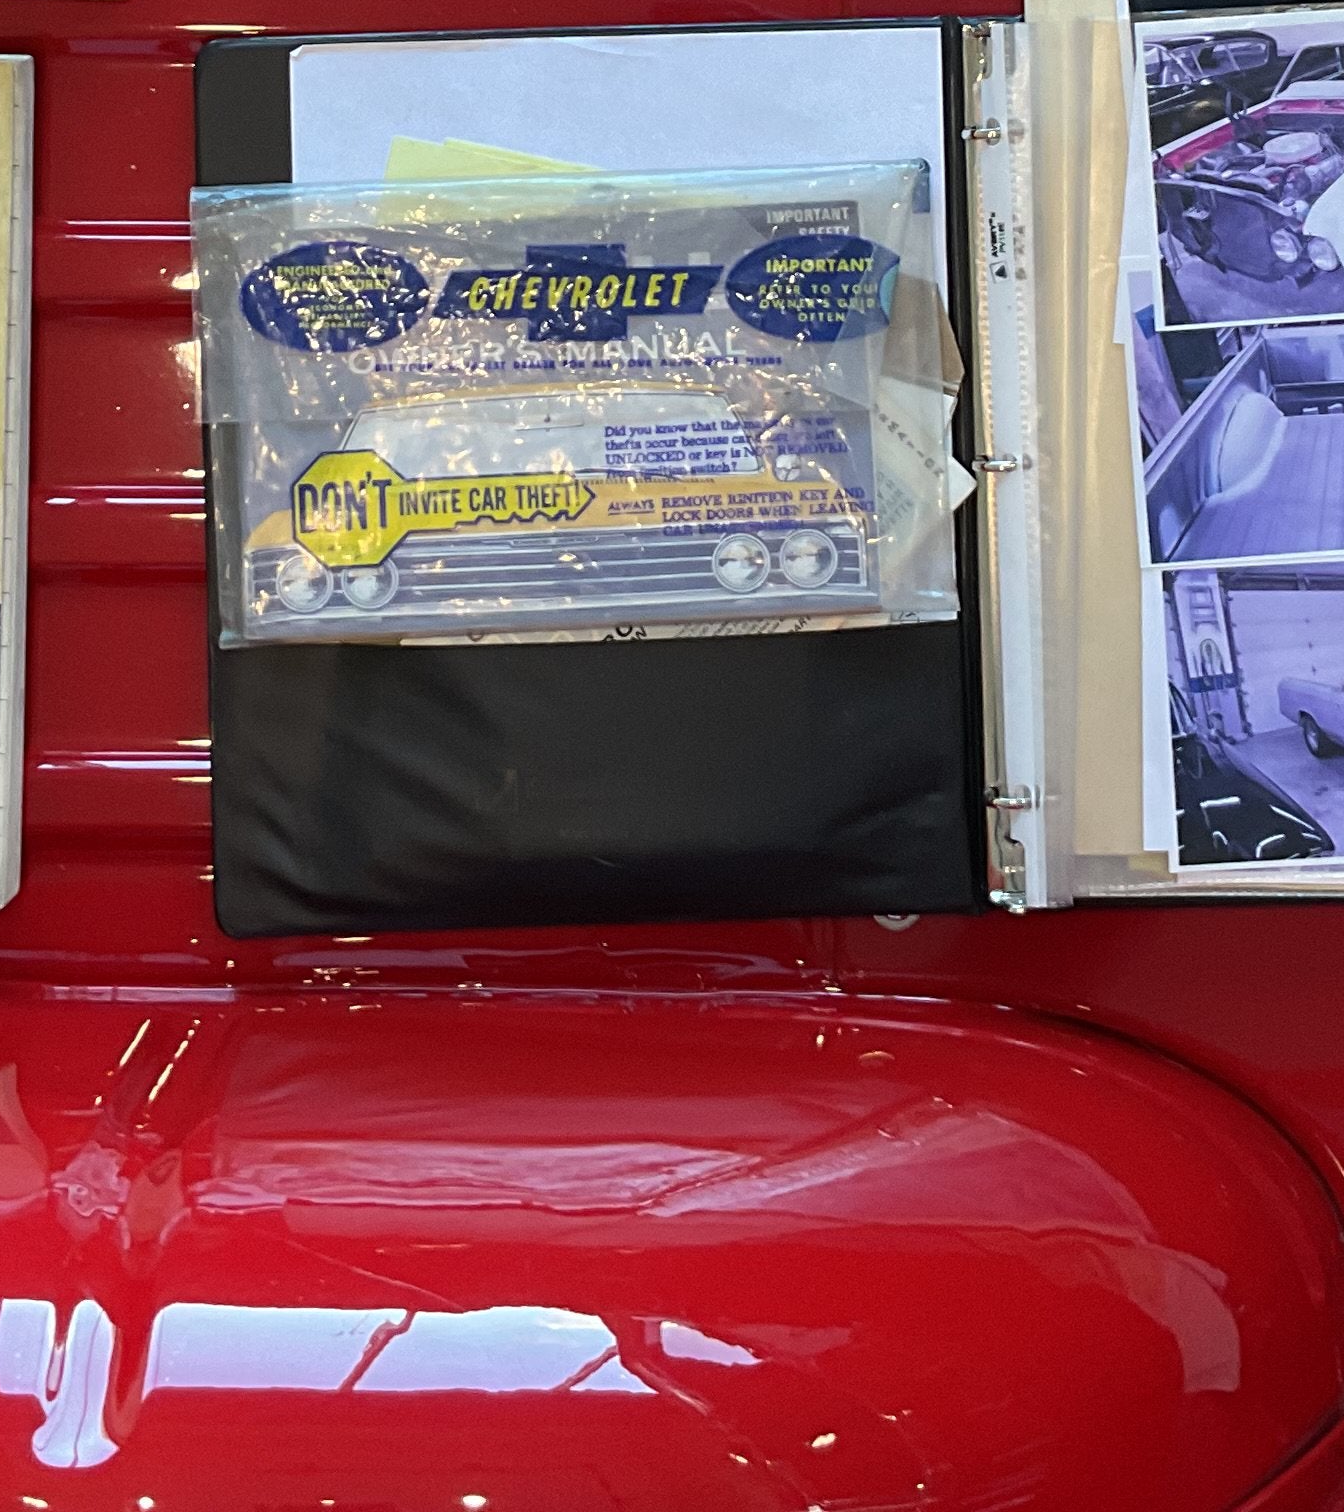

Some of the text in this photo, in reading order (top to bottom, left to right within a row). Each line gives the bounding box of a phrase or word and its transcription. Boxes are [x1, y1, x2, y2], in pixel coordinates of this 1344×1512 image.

[766, 206, 849, 224] IMPORTANT
[765, 258, 874, 273] IMPORTANT
[467, 271, 690, 312] CHEVROLET
[347, 333, 747, 375] OWNER'S MANUAL
[605, 426, 627, 438] Did
[629, 425, 653, 439] you
[655, 421, 689, 435] know
[692, 421, 718, 433] that
[605, 438, 643, 452] thefts
[681, 434, 729, 447] because
[605, 450, 685, 465] UNLOCKED
[689, 451, 704, 461] or
[706, 448, 727, 463] key
[296, 474, 582, 534] DON'T INVITE CAR THEFT!
[608, 499, 655, 511] ALWAYS
[662, 494, 722, 508] REMOVE
[728, 490, 793, 505] IGNITION
[800, 488, 828, 501] KEY
[662, 509, 702, 522] LOCK
[706, 506, 754, 520] DOORS
